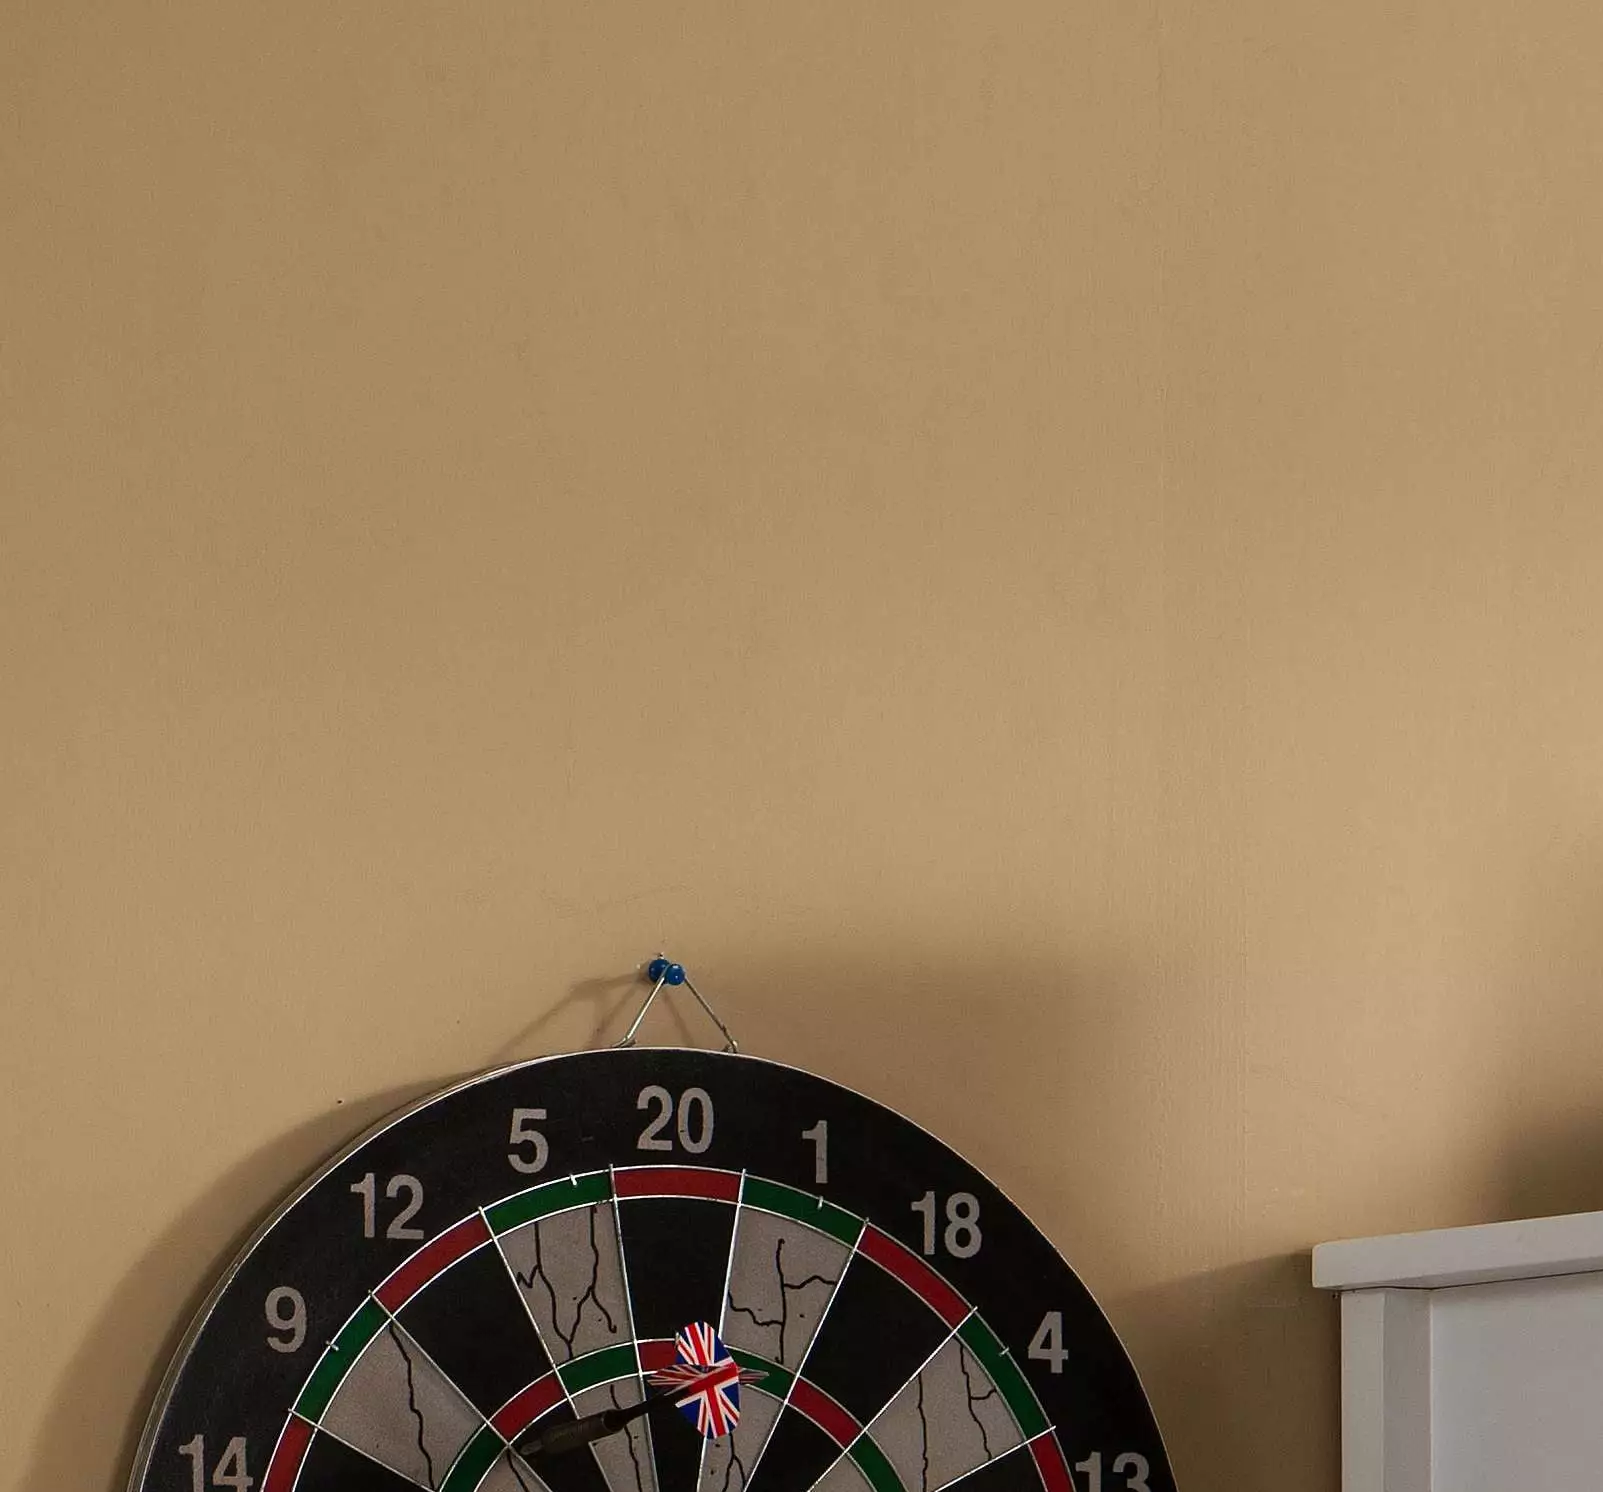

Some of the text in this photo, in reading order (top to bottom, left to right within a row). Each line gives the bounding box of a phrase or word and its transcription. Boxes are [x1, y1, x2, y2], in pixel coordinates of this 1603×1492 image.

[508, 1108, 549, 1174] 5
[638, 1085, 714, 1154] 20
[802, 1120, 828, 1184] 1
[350, 1172, 424, 1240] 12
[911, 1191, 982, 1259] 18
[265, 1286, 307, 1353] 9
[1028, 1311, 1069, 1373] 4
